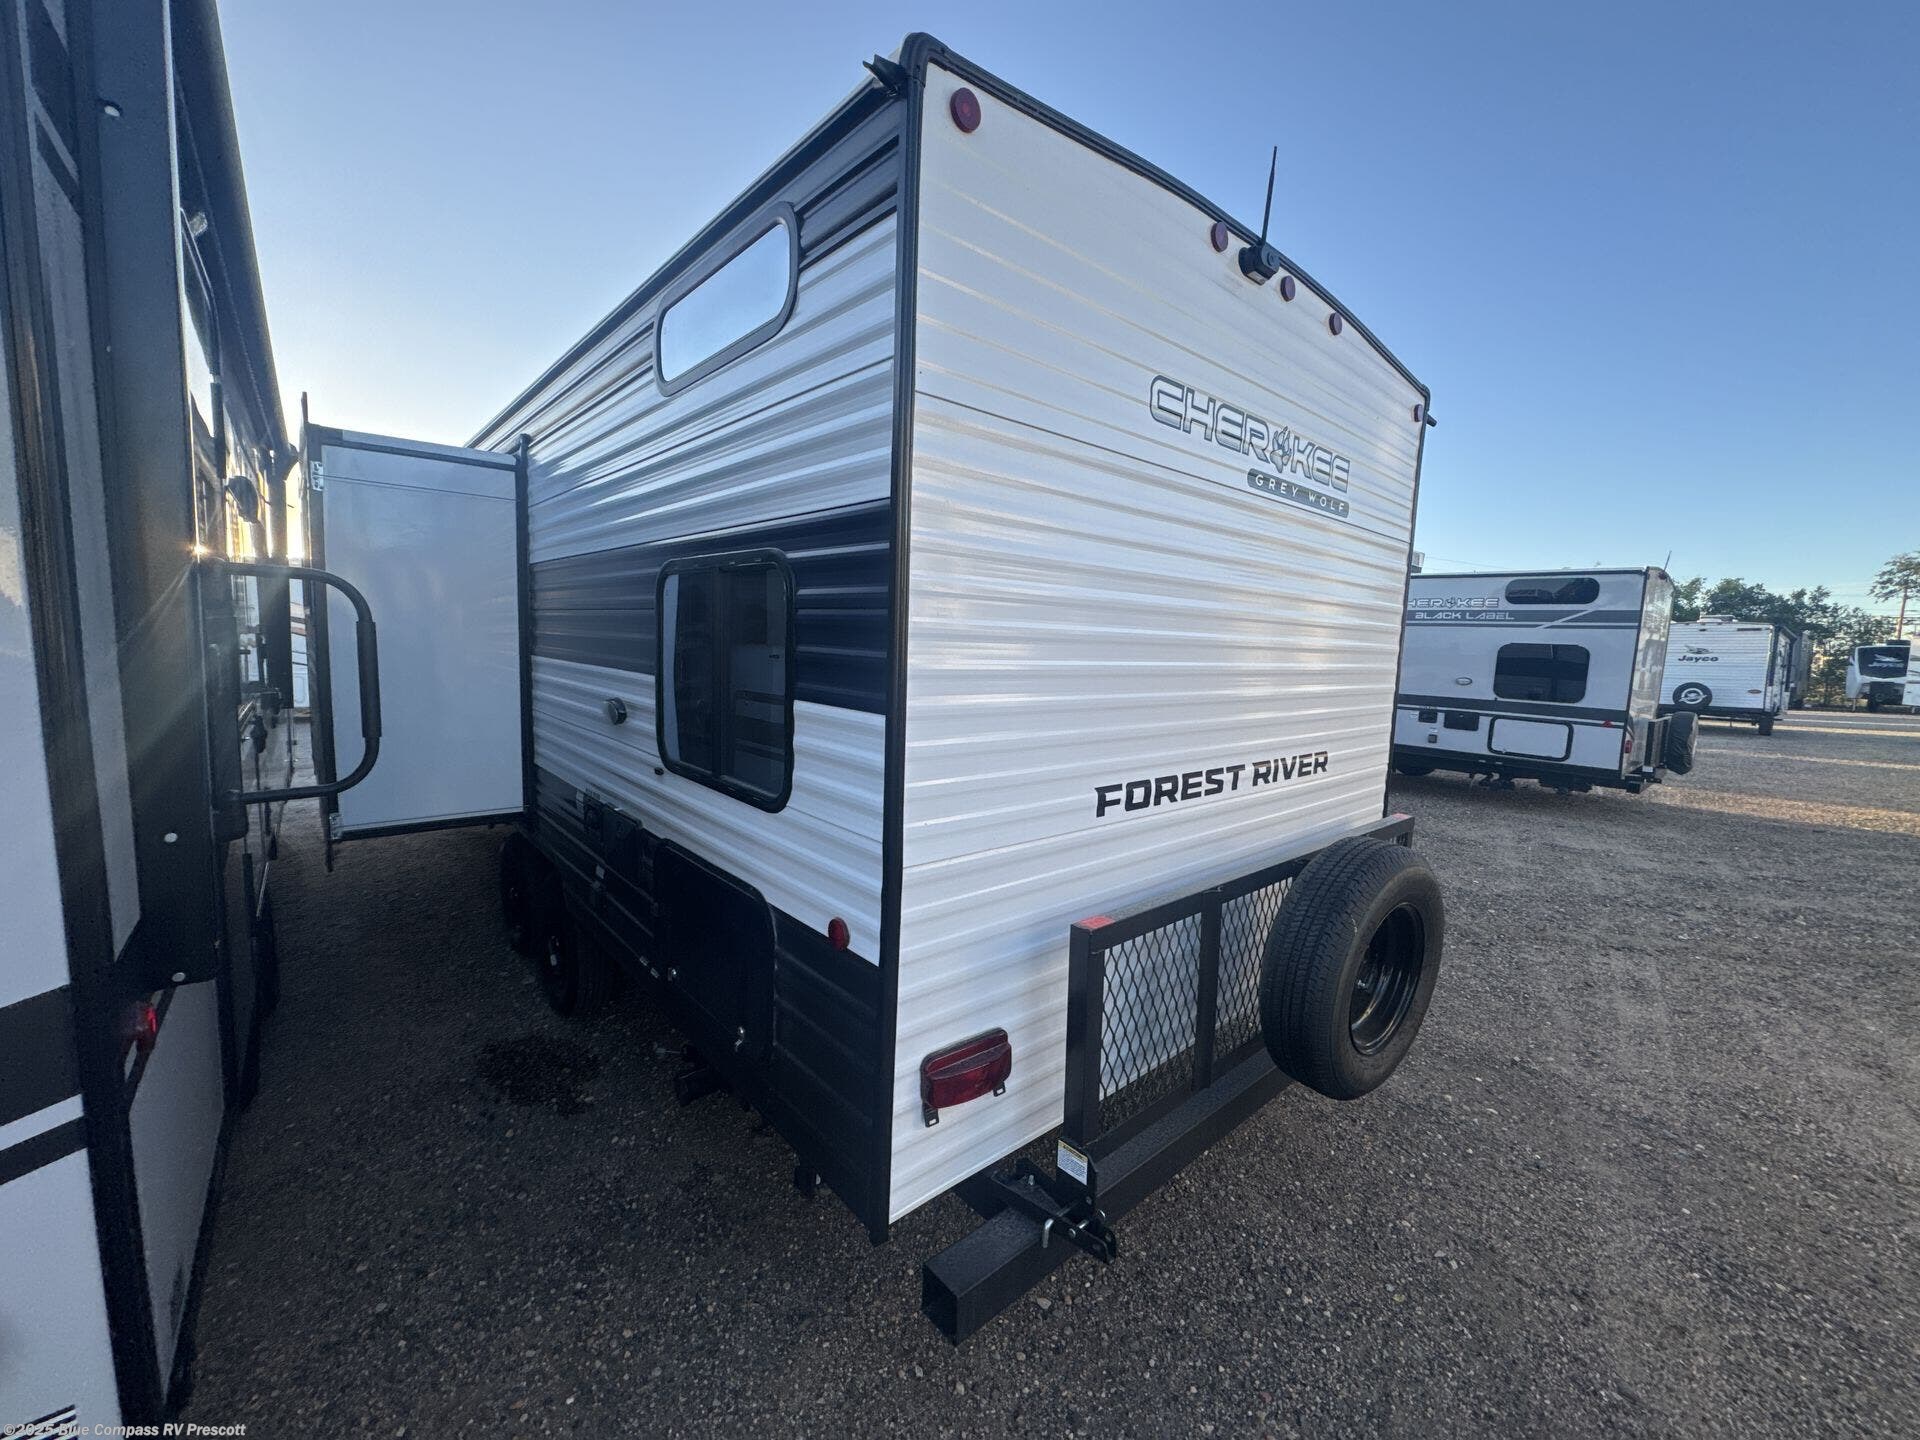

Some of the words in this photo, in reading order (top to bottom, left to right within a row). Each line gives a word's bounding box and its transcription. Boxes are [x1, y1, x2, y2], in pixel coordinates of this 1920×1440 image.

[1255, 473, 1300, 498] GREY
[1308, 490, 1346, 513] WOLF
[1407, 597, 1500, 609] HEROKEE
[1414, 611, 1462, 620] BLACK
[1465, 611, 1516, 620] LABEL
[1677, 654, 1719, 663] Jayco
[1094, 763, 1246, 818] FOREST
[1251, 750, 1329, 787] RIVER
